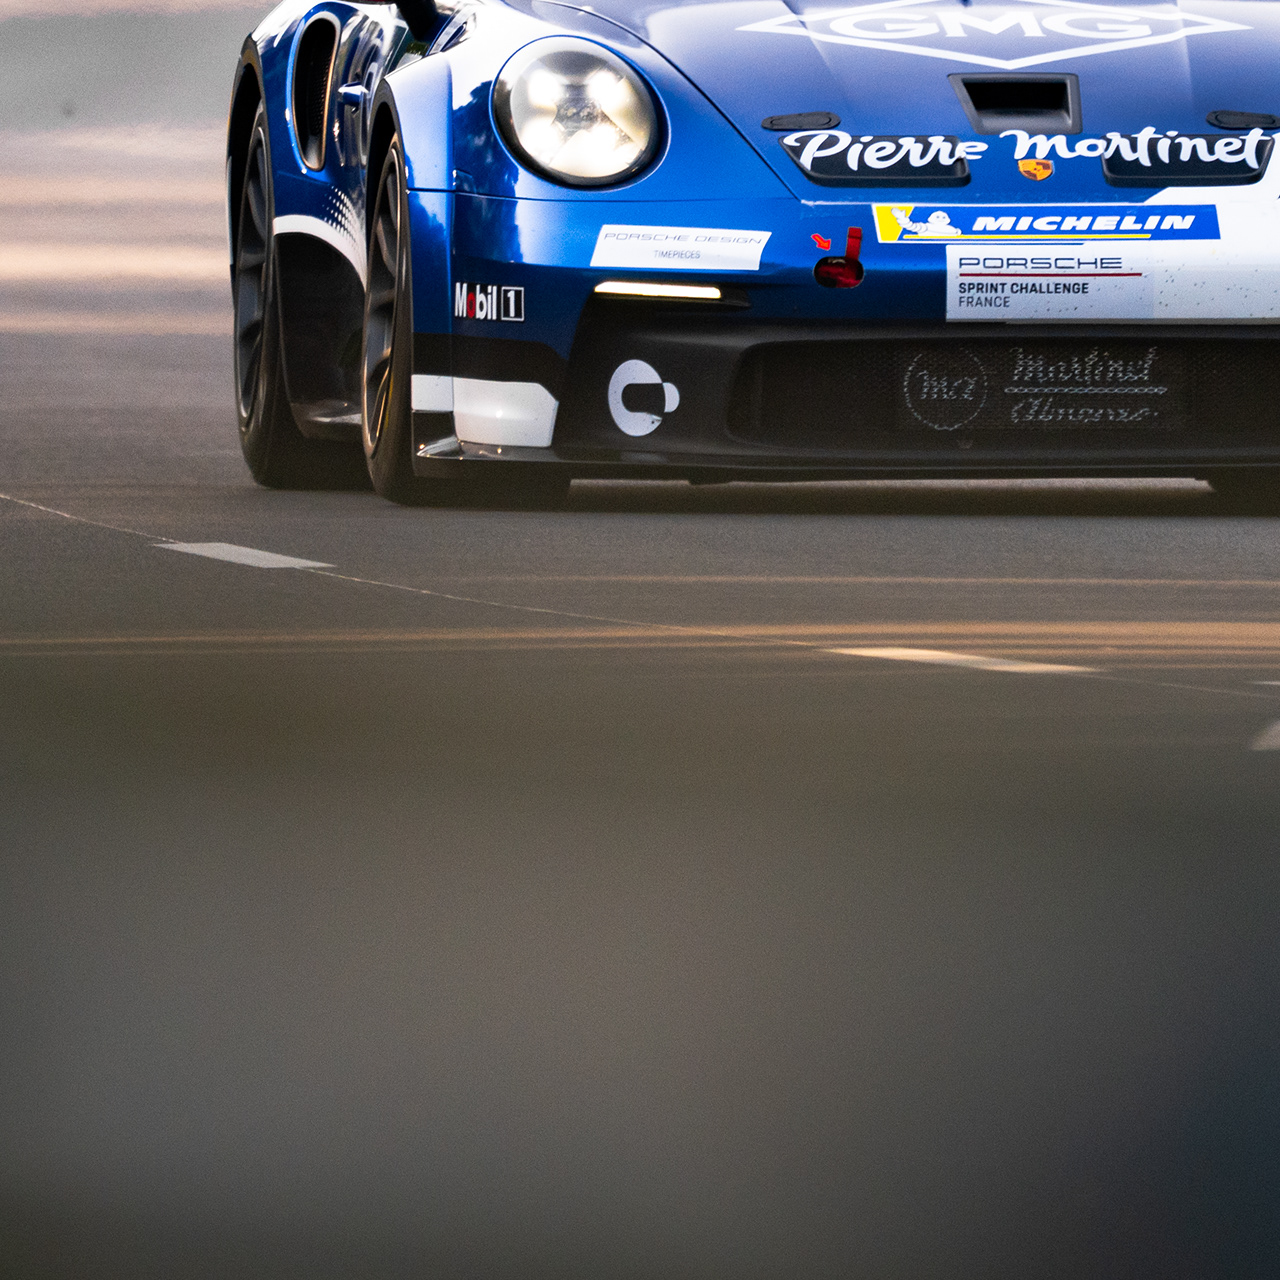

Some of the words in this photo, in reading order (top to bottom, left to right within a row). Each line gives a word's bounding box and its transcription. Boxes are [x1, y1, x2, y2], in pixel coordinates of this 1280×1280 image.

[829, 11, 1153, 40] GMG
[782, 129, 989, 172] Pierre
[971, 214, 1196, 232] MICHELIN
[603, 232, 690, 242] PORSCHE
[694, 235, 763, 245] DESIGN
[654, 249, 700, 259] TIMEPIECES
[958, 256, 1123, 270] PORSCHE
[958, 282, 1008, 295] SPRINT
[1010, 282, 1090, 295] CHALLENGE
[454, 282, 498, 320] Mobil
[958, 295, 1010, 309] FRANCE
